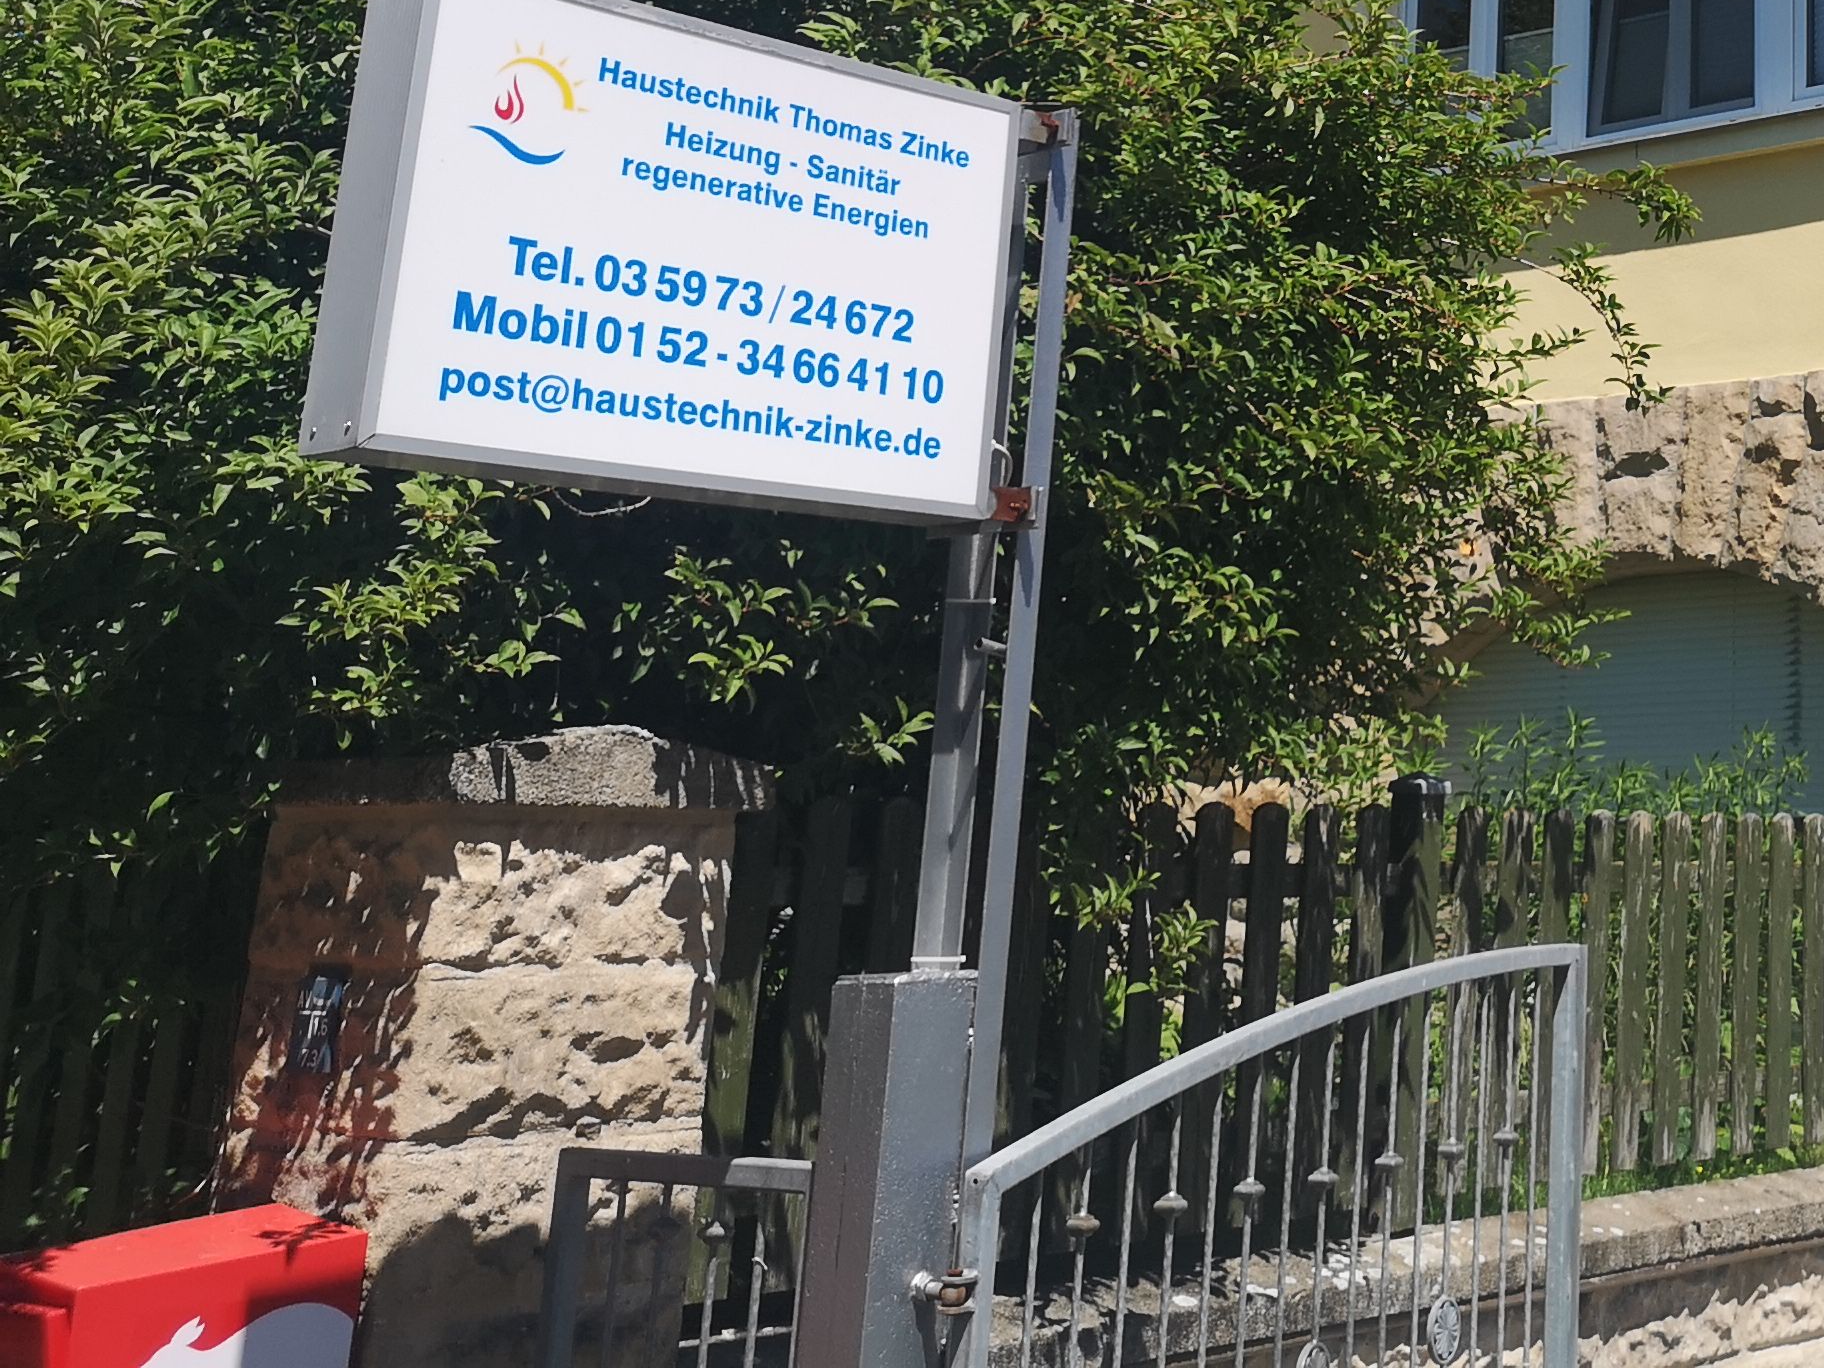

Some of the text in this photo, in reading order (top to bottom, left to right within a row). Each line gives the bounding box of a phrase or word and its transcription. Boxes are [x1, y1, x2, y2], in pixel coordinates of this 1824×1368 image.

[597, 56, 971, 169] Haustechnik Thomas Zinke
[620, 155, 929, 240] regenerative Energien
[664, 121, 781, 177] Heizung
[805, 153, 902, 198] Sanitär
[507, 235, 586, 288] Tel.
[452, 289, 588, 351] Mobil
[439, 366, 942, 461] post@haustechnik-zinke.de
